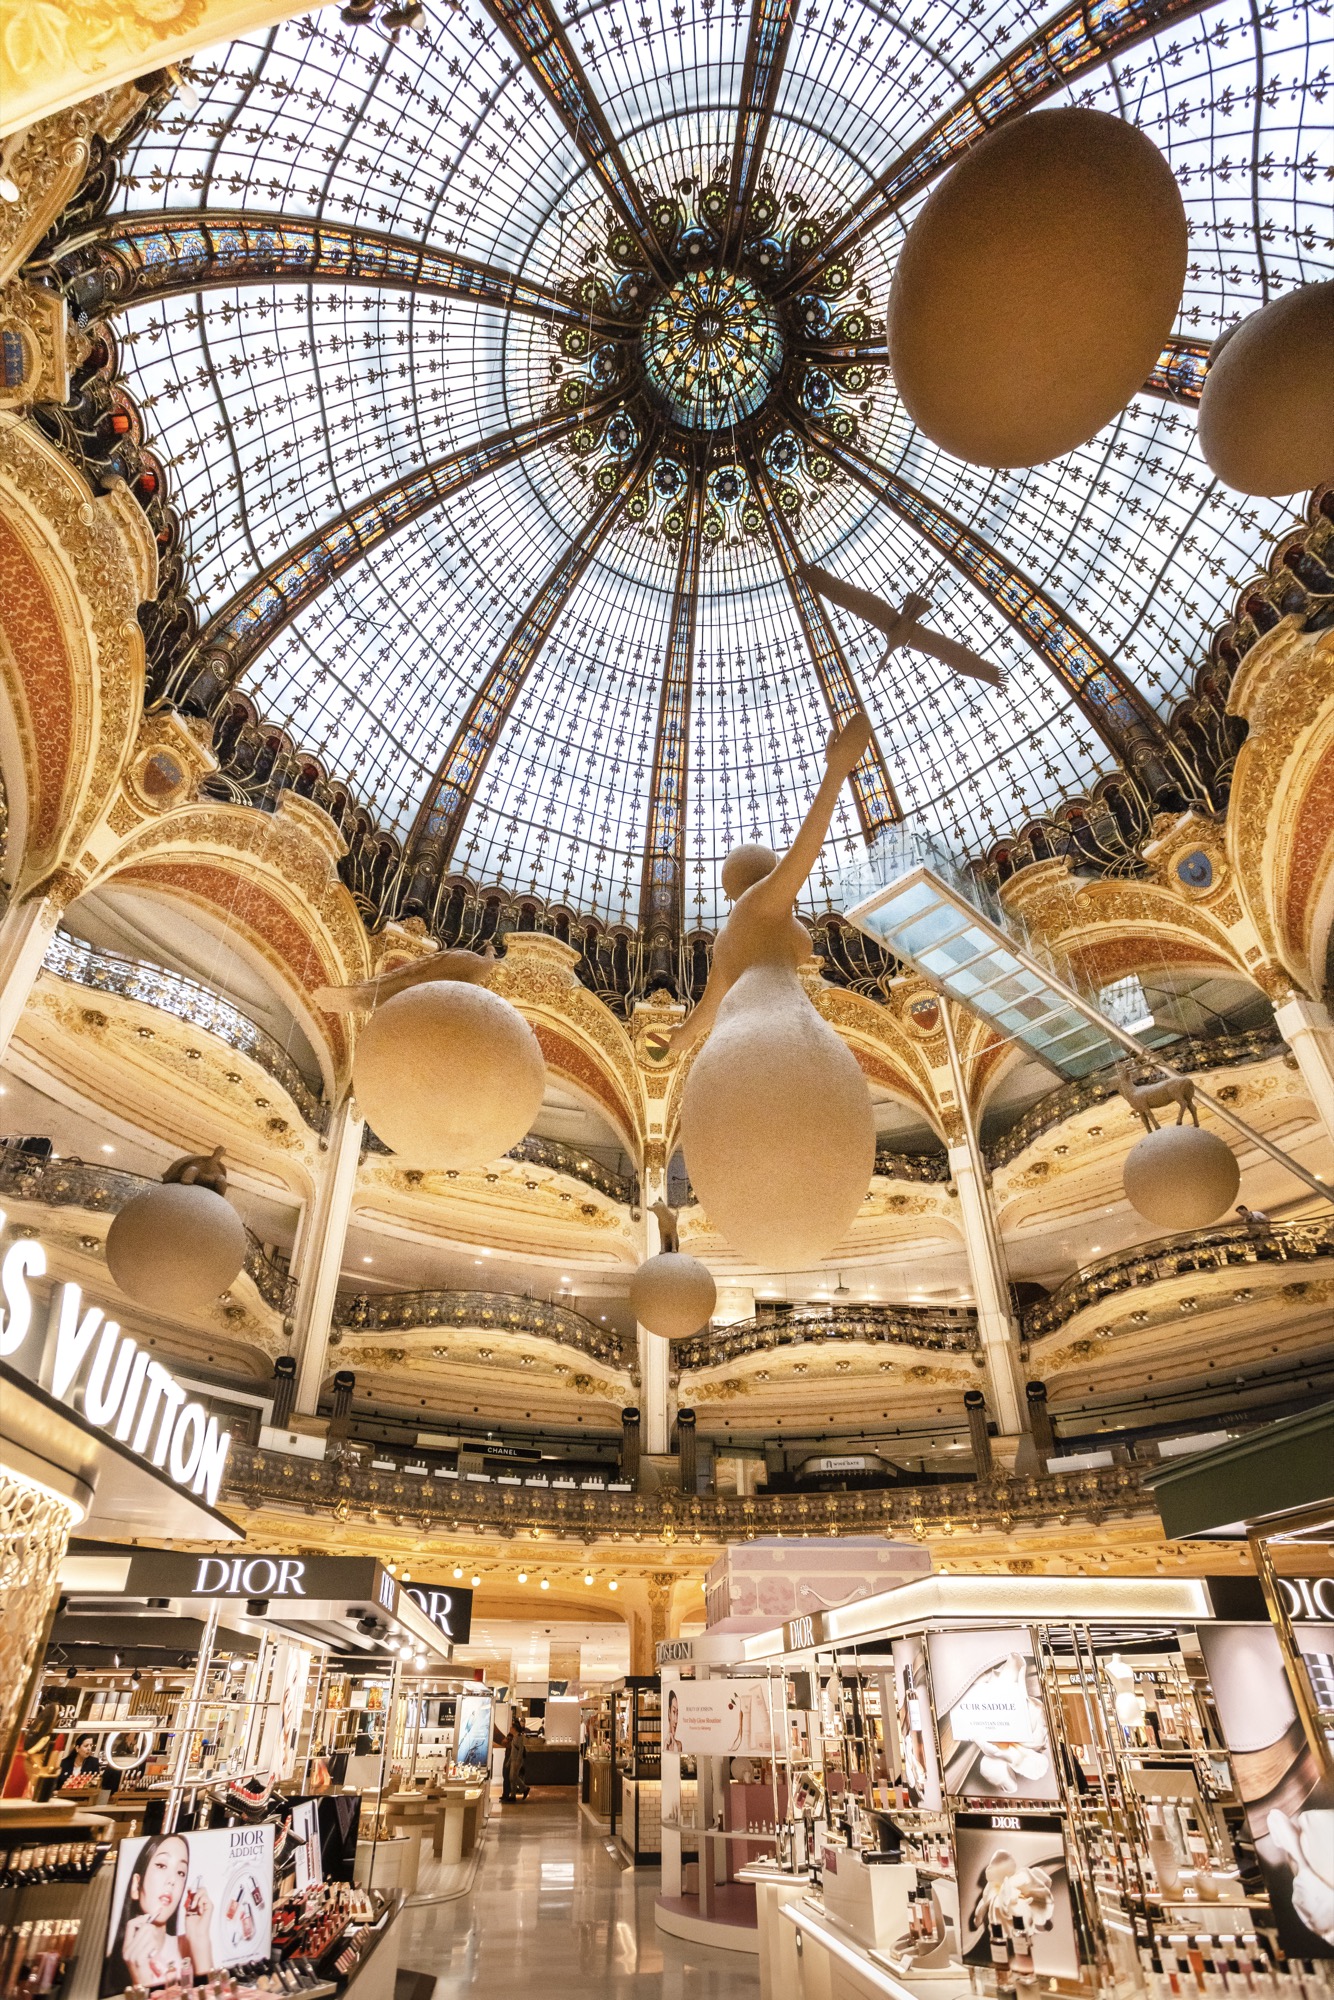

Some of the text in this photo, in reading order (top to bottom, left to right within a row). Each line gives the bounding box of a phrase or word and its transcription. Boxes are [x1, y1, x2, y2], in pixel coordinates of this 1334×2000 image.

[52, 1283, 231, 1507] VUITTON
[487, 1447, 518, 1456] CHANEL
[191, 1558, 307, 1595] DIOR
[379, 1571, 395, 1612] DIOR
[788, 1616, 815, 1650] DIOR
[960, 1703, 1016, 1711] CUIR SADDLE
[991, 1816, 1021, 1830] DIOR
[230, 1830, 264, 1848] DIOR
[229, 1845, 265, 1858] ADDICT
